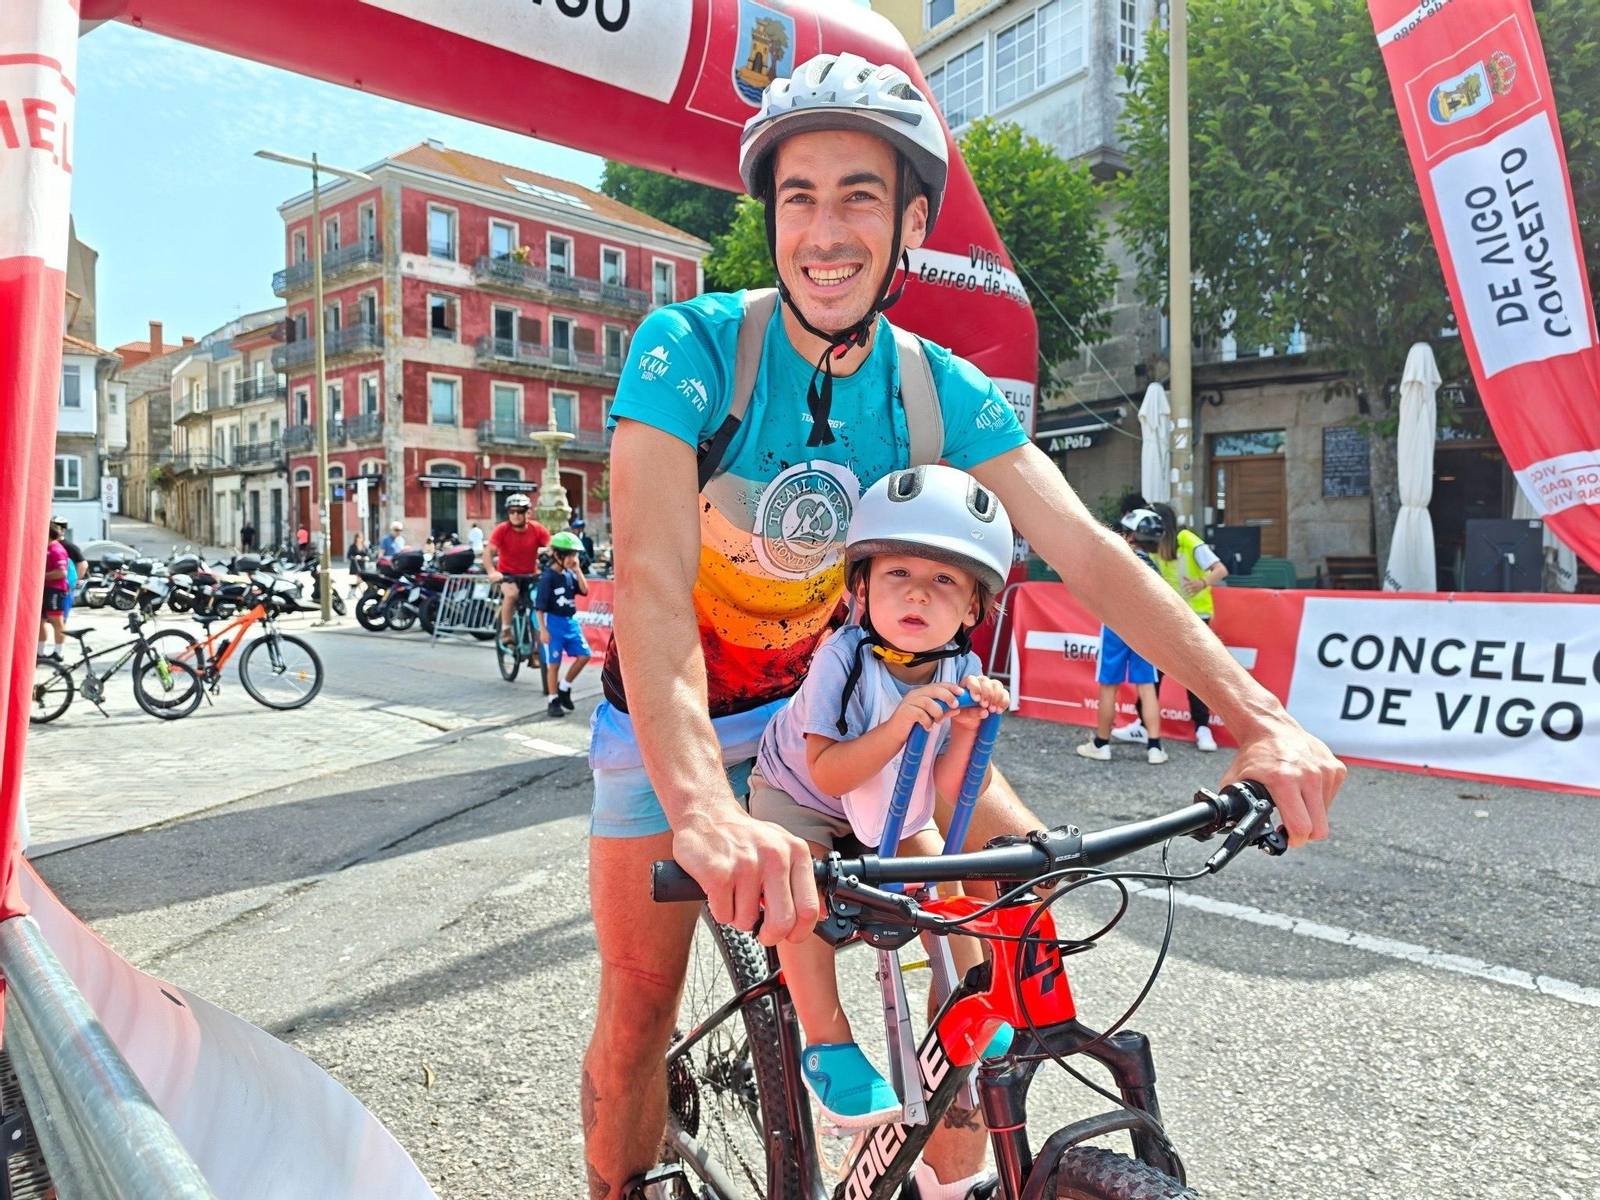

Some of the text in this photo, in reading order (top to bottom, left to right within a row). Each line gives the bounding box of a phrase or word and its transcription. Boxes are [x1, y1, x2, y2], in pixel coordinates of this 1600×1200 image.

[919, 262, 977, 291] terreo
[983, 275, 1000, 295] de
[975, 410, 990, 430] 40
[987, 400, 1005, 420] KM
[769, 478, 849, 531] TRAIL ORIXES
[1064, 639, 1100, 662] terr
[1317, 632, 1600, 685] CONCELL
[1160, 708, 1192, 722] CIDAD
[1340, 685, 1584, 741] DE VIGO
[845, 1031, 950, 1200] APIEE
